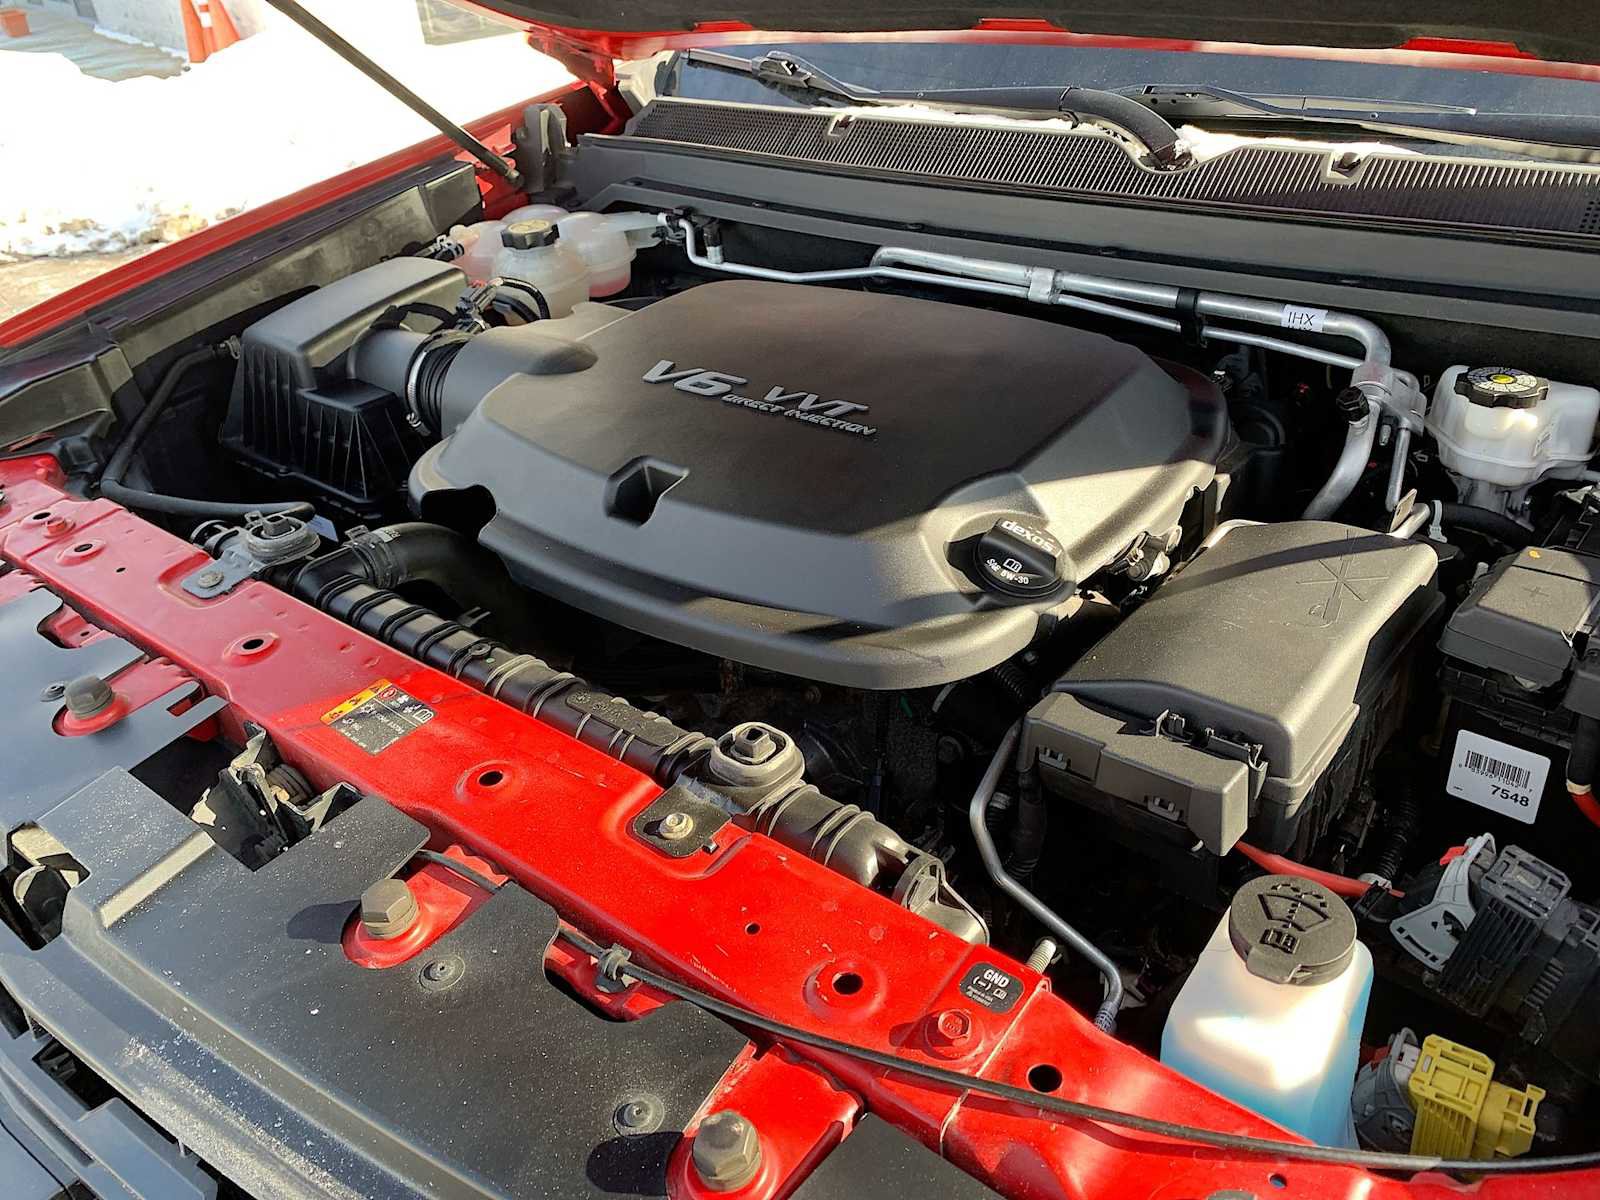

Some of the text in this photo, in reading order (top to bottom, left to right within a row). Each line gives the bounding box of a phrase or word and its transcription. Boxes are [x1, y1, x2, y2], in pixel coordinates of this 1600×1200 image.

[1288, 311, 1316, 326] IHX
[642, 359, 870, 417] V6 VVT
[721, 393, 877, 436] DIRECT INJECTION
[986, 558, 1001, 572] SAE
[1490, 784, 1530, 807] 7548
[983, 968, 1010, 988] GND
